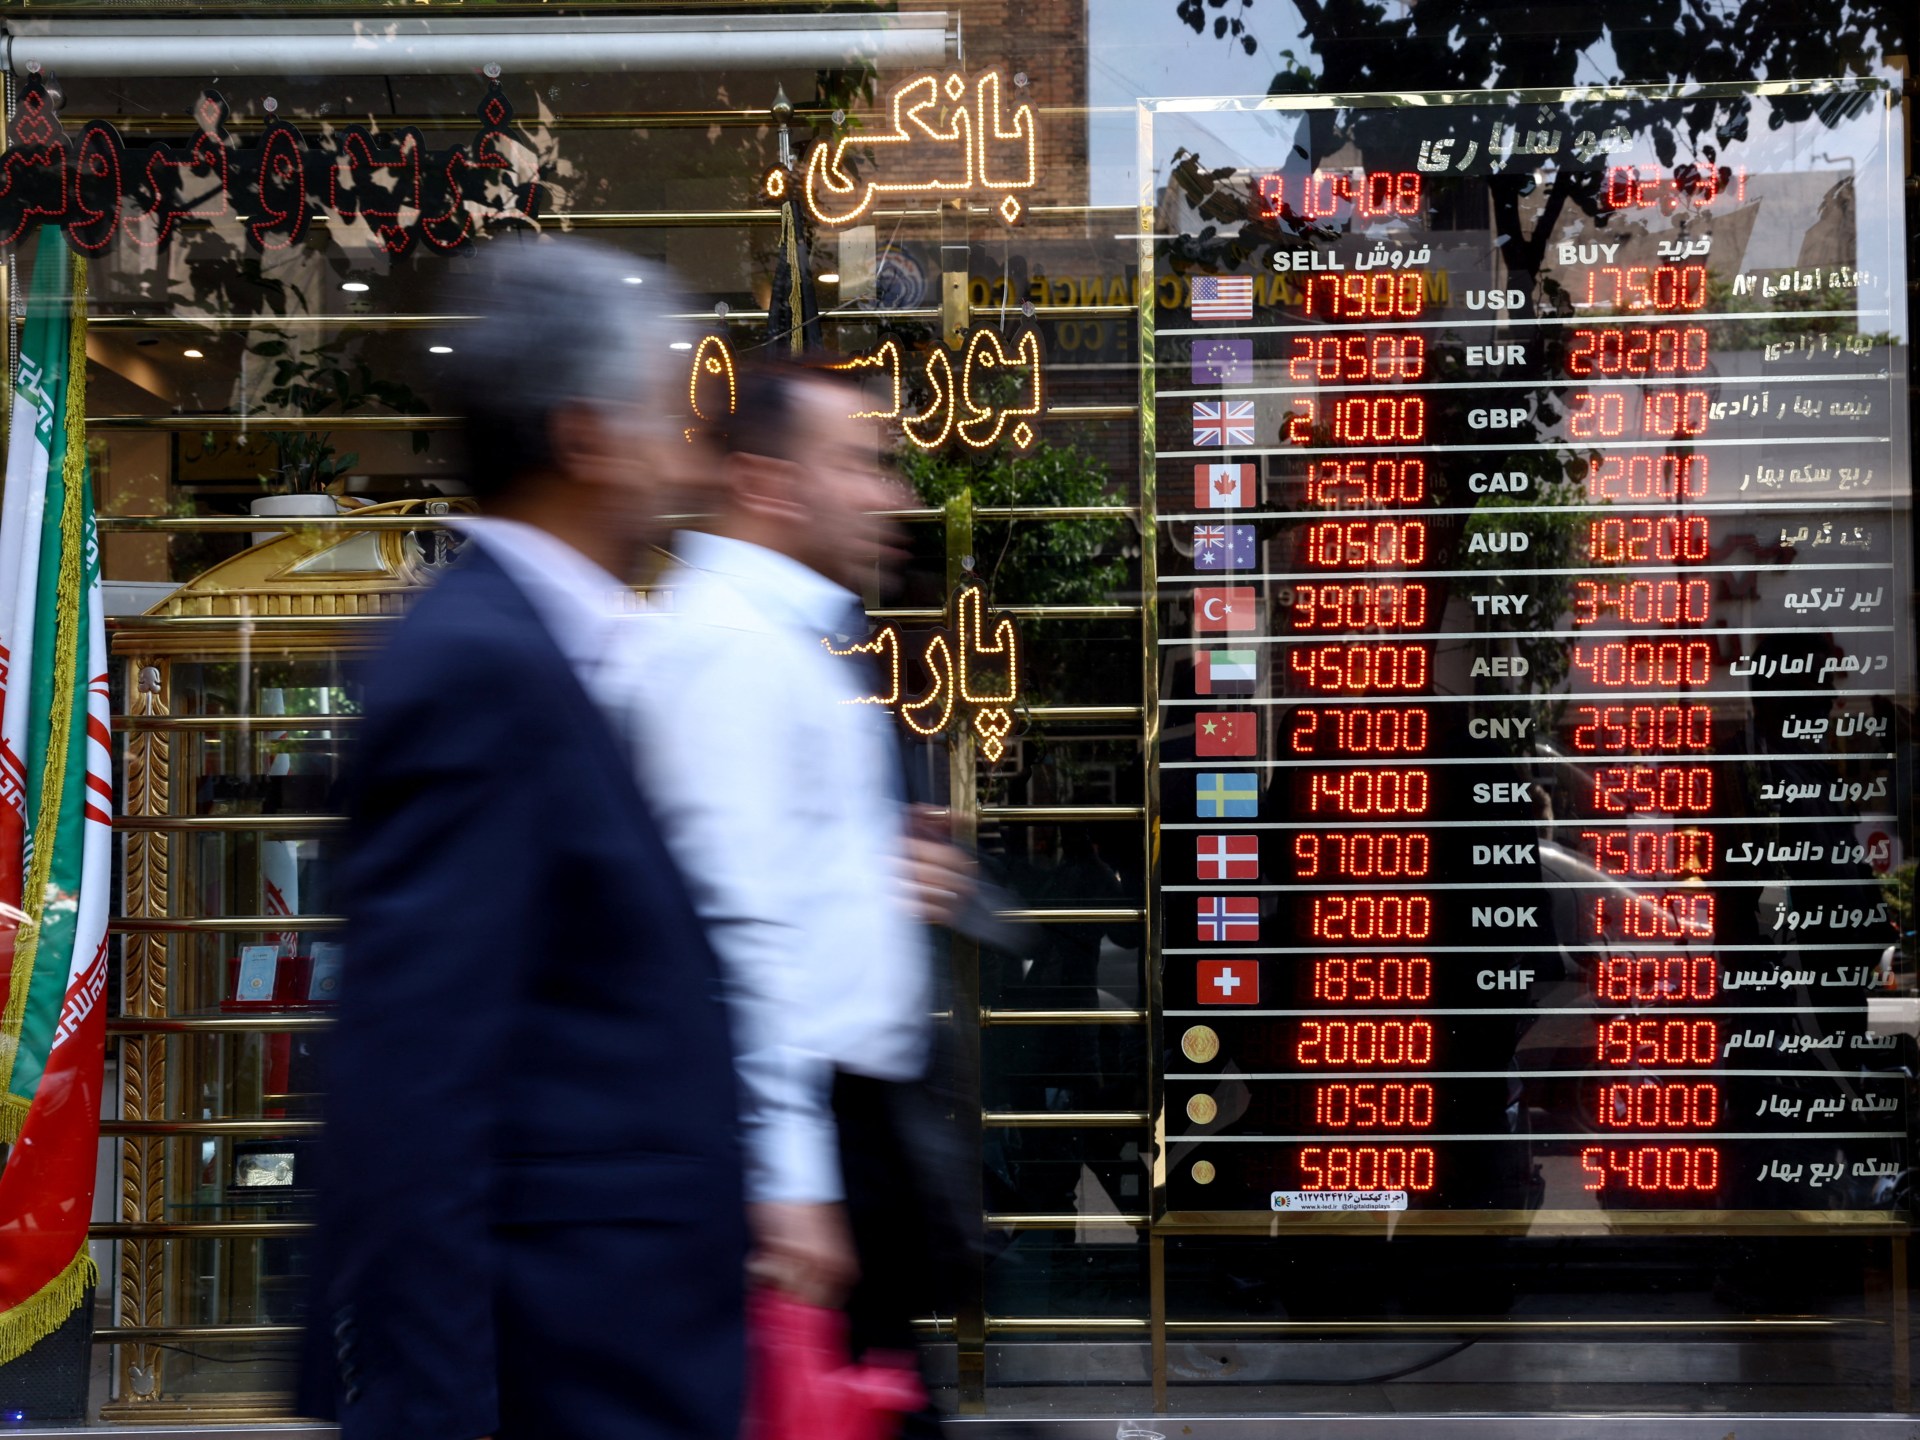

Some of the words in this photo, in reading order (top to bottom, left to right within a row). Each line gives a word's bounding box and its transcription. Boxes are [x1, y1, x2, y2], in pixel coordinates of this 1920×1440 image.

[1273, 250, 1345, 272] SELL
[1355, 242, 1431, 271] فروش
[1558, 244, 1620, 266] BUY
[1656, 240, 1711, 262] خرید
[1308, 275, 1422, 317] 17900
[1466, 290, 1525, 311] USD
[1588, 266, 1706, 310] 17500
[1289, 336, 1424, 380] 20500
[1466, 345, 1527, 367] EUR
[1571, 329, 1707, 374] 20200
[1290, 398, 1424, 442] 21000
[1467, 408, 1528, 430] GBP
[1571, 392, 1708, 436] 20100
[1708, 391, 1770, 420] آزادی
[1308, 460, 1424, 503] 12500
[1468, 472, 1529, 494] CAD
[1591, 455, 1708, 499] 12000
[1739, 465, 1785, 491] بهار
[1789, 464, 1832, 483] سکه
[1309, 522, 1425, 565] 10500
[1468, 532, 1530, 553] AUD
[1591, 517, 1708, 561] 10200
[1294, 585, 1426, 628] 39000
[1472, 594, 1529, 615] TRY
[1575, 580, 1709, 625] 34000
[1784, 587, 1846, 614] ترکیه
[1849, 587, 1884, 613] لیر
[1292, 646, 1426, 690] 45000
[1470, 657, 1530, 678] AED
[1574, 643, 1710, 686] 40000
[1729, 653, 1814, 679] امارات
[1818, 654, 1888, 684] درهم
[1293, 709, 1427, 752] 27000
[1468, 717, 1532, 740] CNY
[1575, 706, 1711, 750] 25000
[1781, 714, 1829, 744] چین
[1836, 712, 1888, 737] یوان
[1312, 771, 1428, 813] 14000
[1472, 782, 1532, 804] SEK
[1594, 769, 1712, 812] 12500
[1760, 779, 1822, 803] سوئد
[1828, 777, 1888, 802] کرون
[1295, 834, 1429, 877] 97000
[1472, 844, 1537, 866] DKK
[1581, 832, 1713, 875] 75000
[1725, 841, 1824, 866] دانمارک
[1831, 839, 1890, 866] کرون
[1314, 897, 1430, 939] 12000
[1472, 907, 1538, 928] NOK
[1597, 895, 1714, 938] 11000
[1772, 902, 1823, 931] نروژ
[1829, 903, 1888, 929] کرون
[1315, 959, 1431, 1001] 18500
[1476, 970, 1536, 991] CHF
[1598, 957, 1715, 1001] 18000
[1298, 1022, 1432, 1064] 20000
[1599, 1021, 1716, 1064] 19500
[1722, 1029, 1775, 1058] امام
[1778, 1031, 1846, 1054] تصویر
[1850, 1031, 1898, 1050] سکه
[1318, 1084, 1433, 1127] 10500
[1600, 1084, 1717, 1127] 10000
[1756, 1094, 1802, 1118] بهار
[1806, 1094, 1846, 1123] نیم
[1851, 1094, 1899, 1112] سکه
[1300, 1148, 1434, 1190] 58000
[1582, 1147, 1718, 1191] 54000
[1757, 1160, 1803, 1182] بهار
[1809, 1162, 1844, 1187] ربع
[1852, 1158, 1900, 1177] سکه
